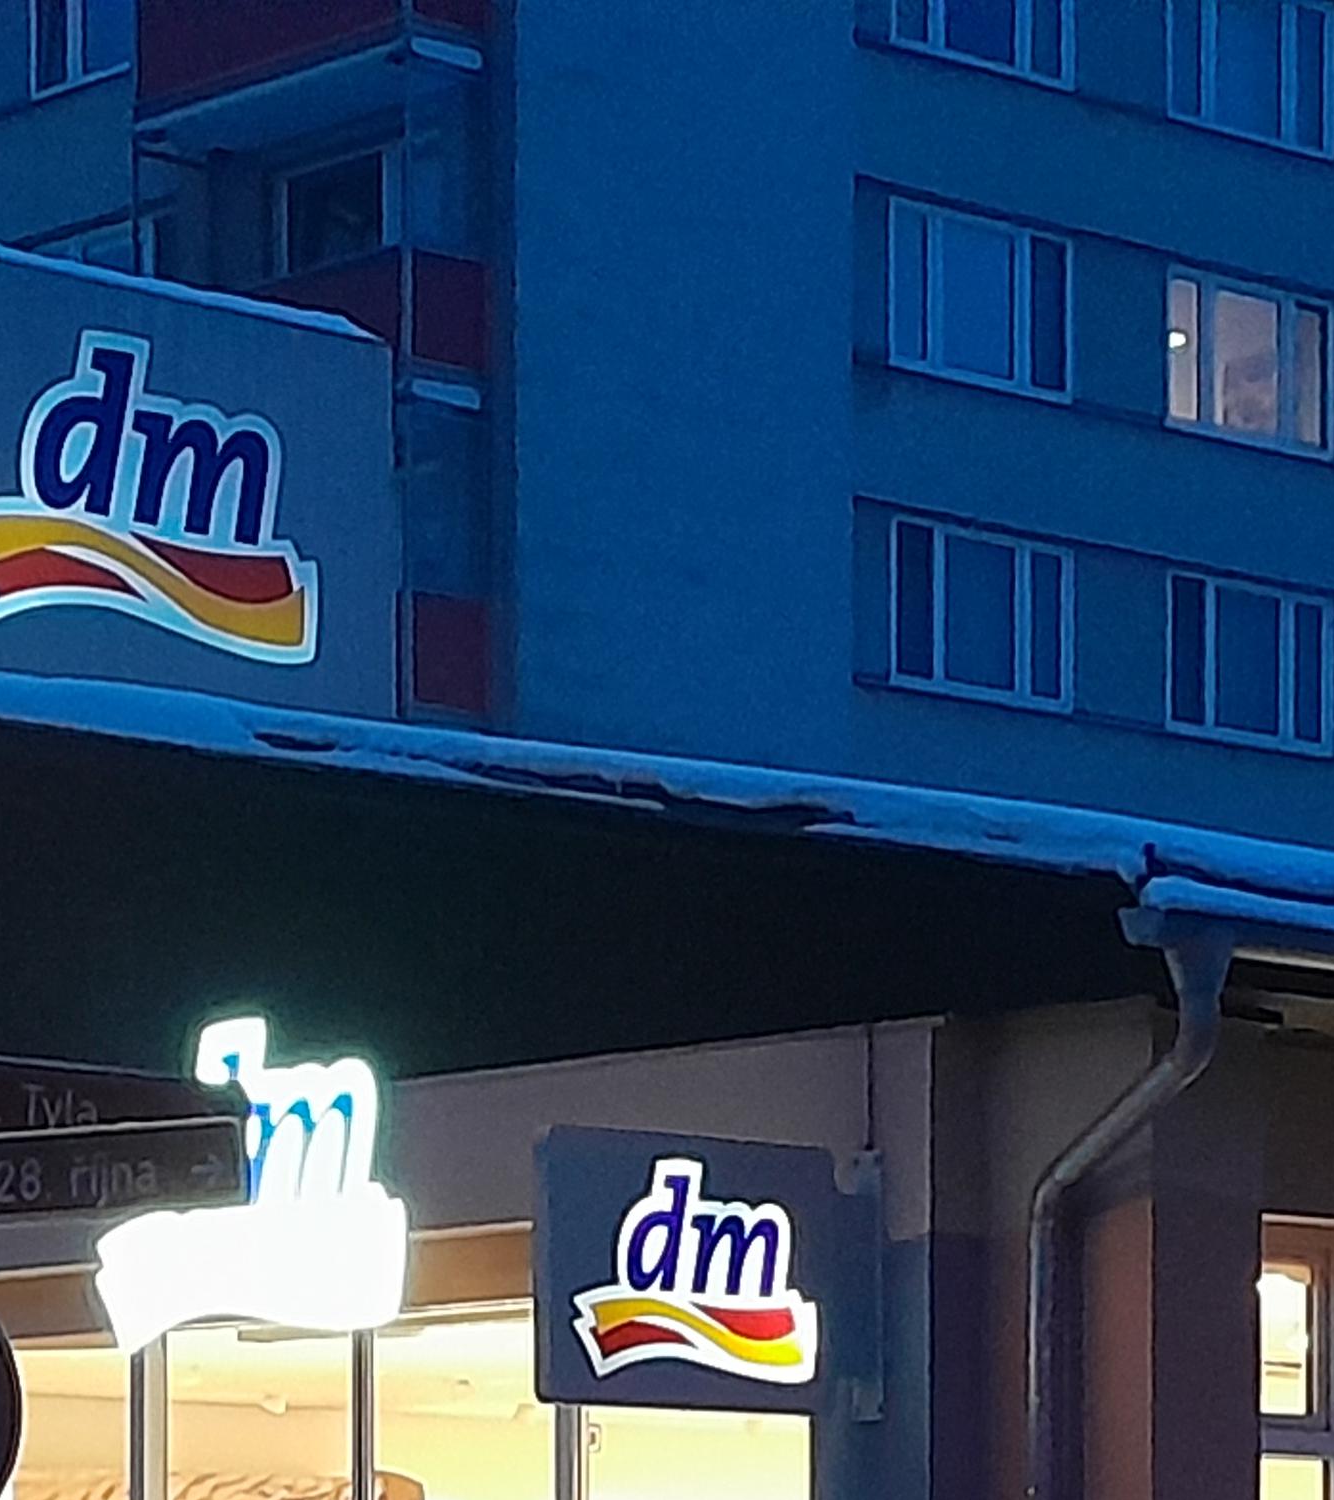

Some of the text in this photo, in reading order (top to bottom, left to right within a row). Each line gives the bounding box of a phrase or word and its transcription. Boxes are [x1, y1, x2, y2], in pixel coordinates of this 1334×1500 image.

[33, 346, 271, 546] dm
[21, 1081, 100, 1128] Tyla
[68, 1152, 158, 1208] října
[626, 1174, 781, 1298] dm
